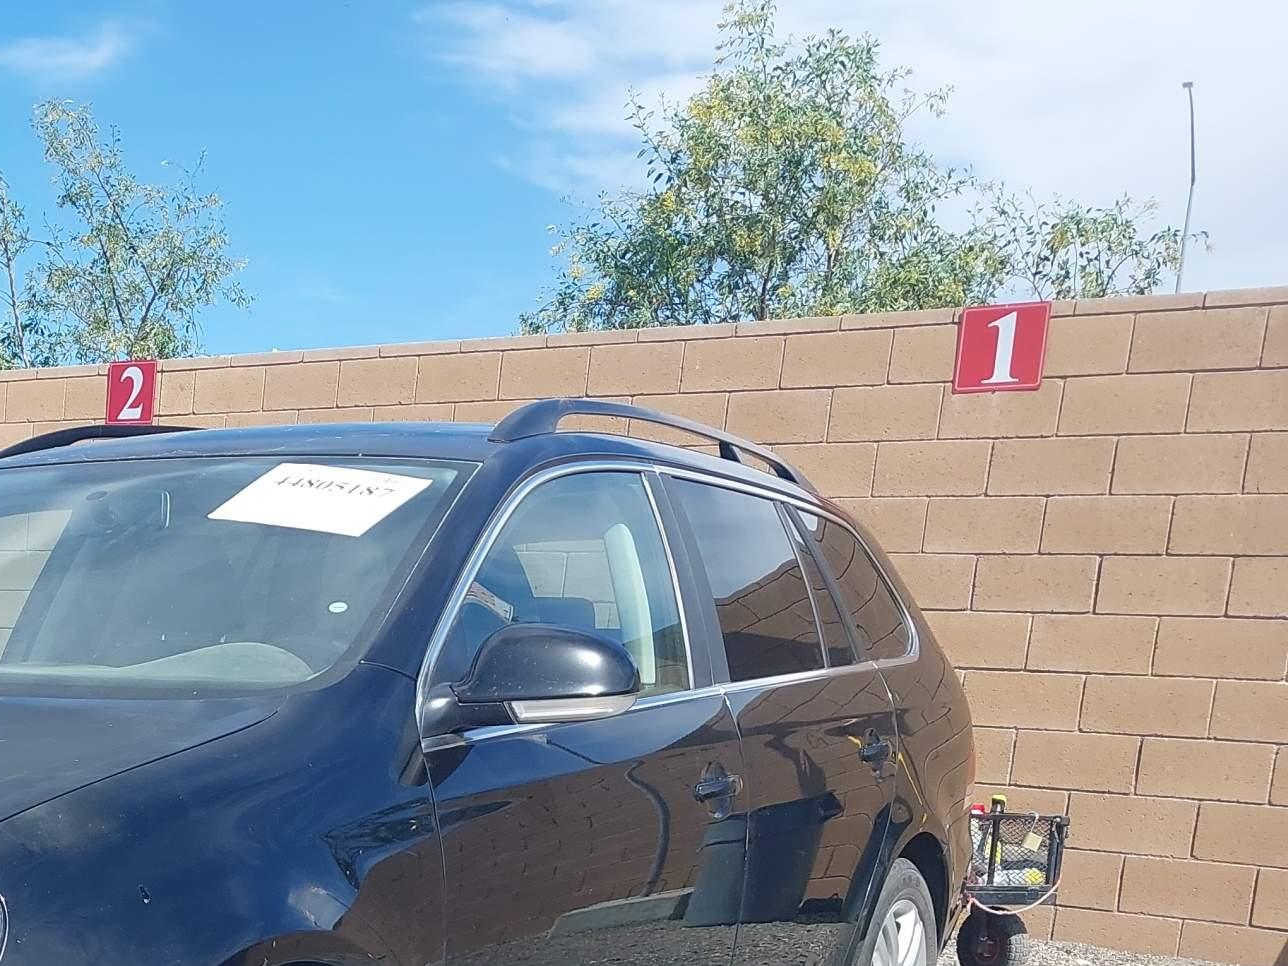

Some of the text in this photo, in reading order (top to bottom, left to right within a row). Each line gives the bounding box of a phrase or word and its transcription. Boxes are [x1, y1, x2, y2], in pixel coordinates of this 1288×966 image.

[981, 311, 1019, 384] 1
[116, 366, 144, 420] 2
[274, 475, 396, 497] 44805187
